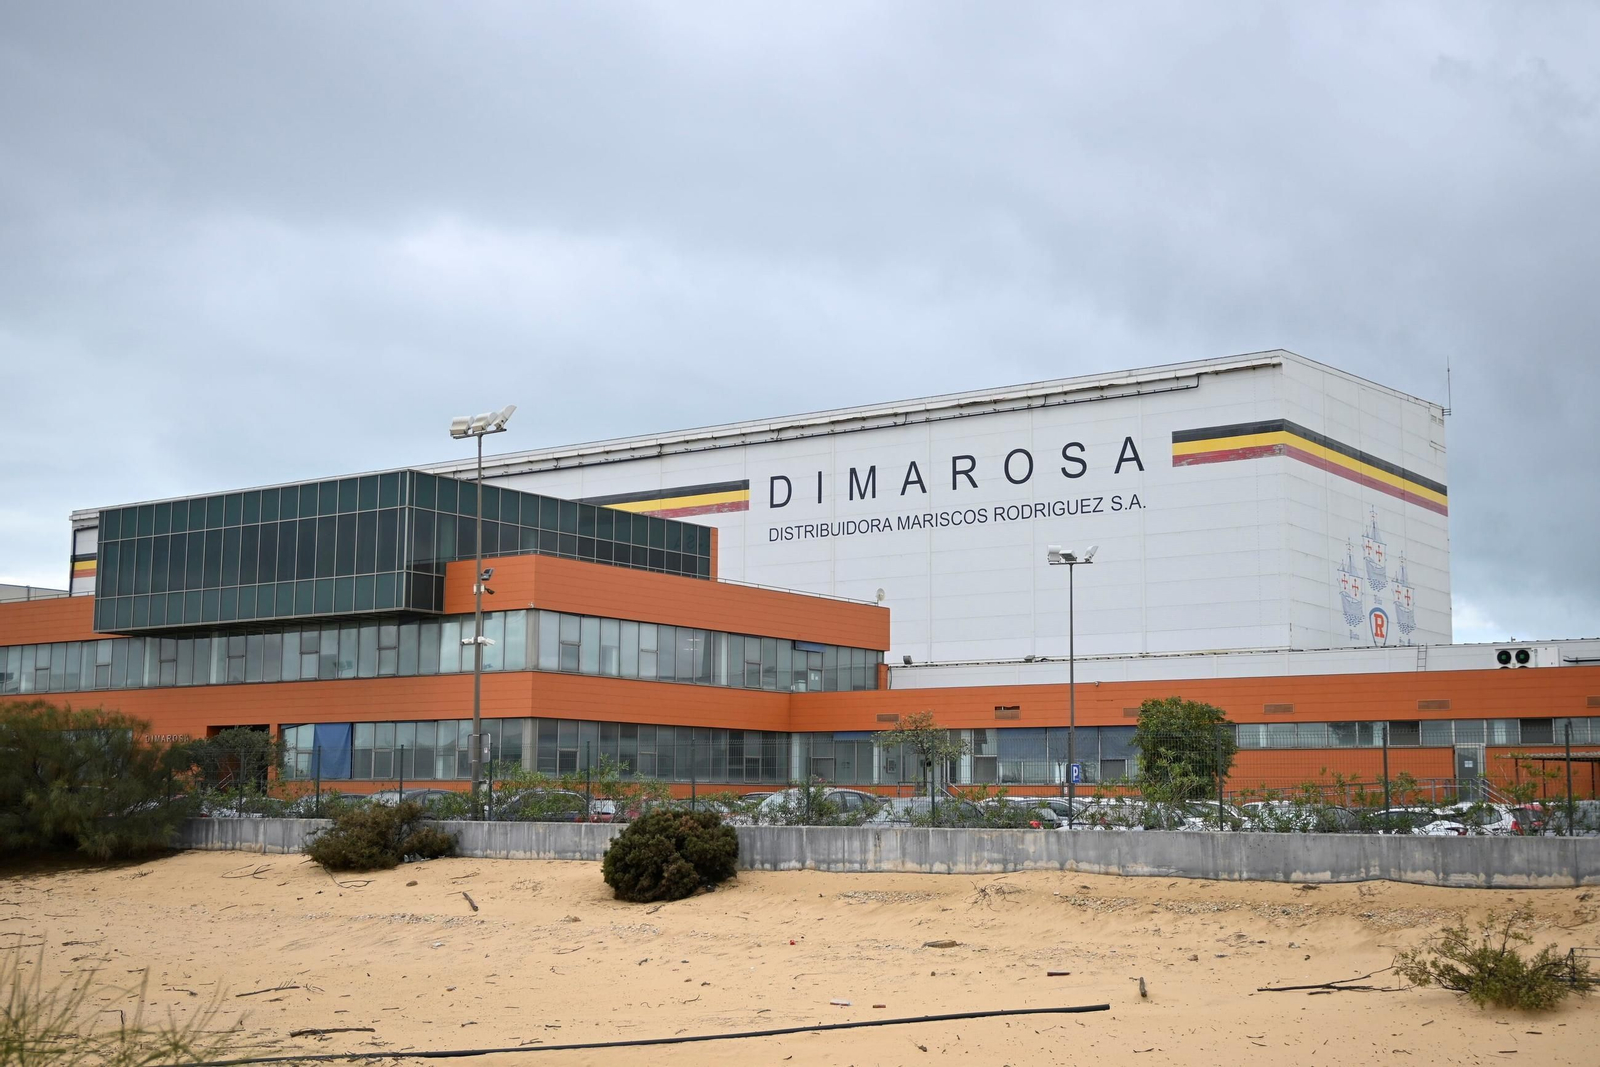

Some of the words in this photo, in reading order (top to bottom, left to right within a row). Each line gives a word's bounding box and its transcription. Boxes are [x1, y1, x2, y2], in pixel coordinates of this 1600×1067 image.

[769, 437, 1145, 508] DIMAROSA
[768, 518, 892, 542] DISTRIBUIDORA
[897, 509, 988, 531] MARISCOS
[993, 497, 1104, 522] RODRIGUEZ
[1111, 493, 1147, 512] S.A.
[1373, 613, 1385, 638] R
[145, 734, 190, 743] DIMAROSA
[1072, 766, 1079, 781] P
